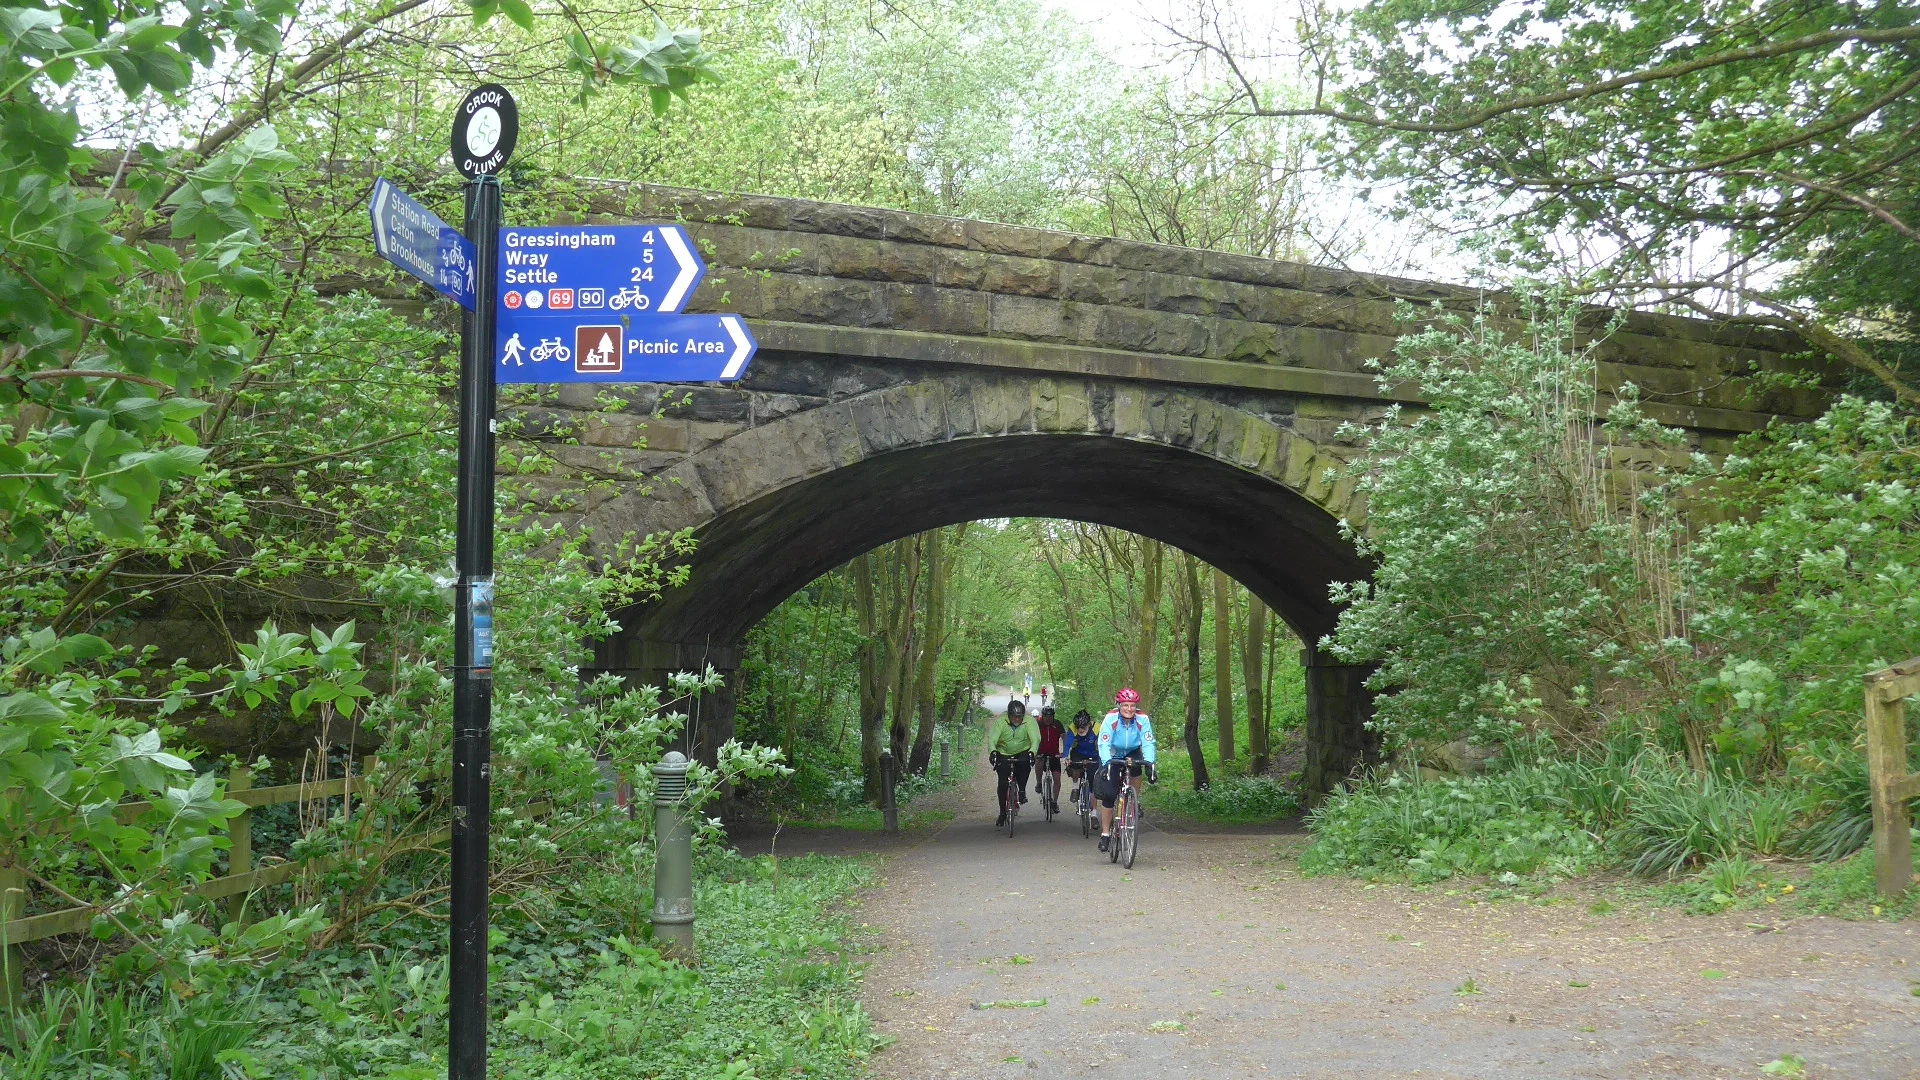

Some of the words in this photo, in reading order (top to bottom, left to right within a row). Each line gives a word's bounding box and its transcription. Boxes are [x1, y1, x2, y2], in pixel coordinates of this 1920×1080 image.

[466, 91, 504, 114] CROOK
[464, 150, 504, 175] O'LUNE
[391, 193, 420, 227] Station
[421, 214, 440, 240] Road
[391, 215, 415, 244] Caton
[505, 232, 616, 250] Gressingham
[641, 230, 655, 246] 4
[390, 235, 435, 277] Brookhouse
[505, 250, 549, 268] Wray
[642, 248, 654, 264] 5
[453, 273, 461, 291] 90
[505, 268, 558, 284] Settle
[630, 266, 655, 282] 24
[551, 292, 571, 305] 69
[582, 292, 601, 305] 90
[628, 338, 679, 354] Picnic
[684, 338, 725, 354] Area
